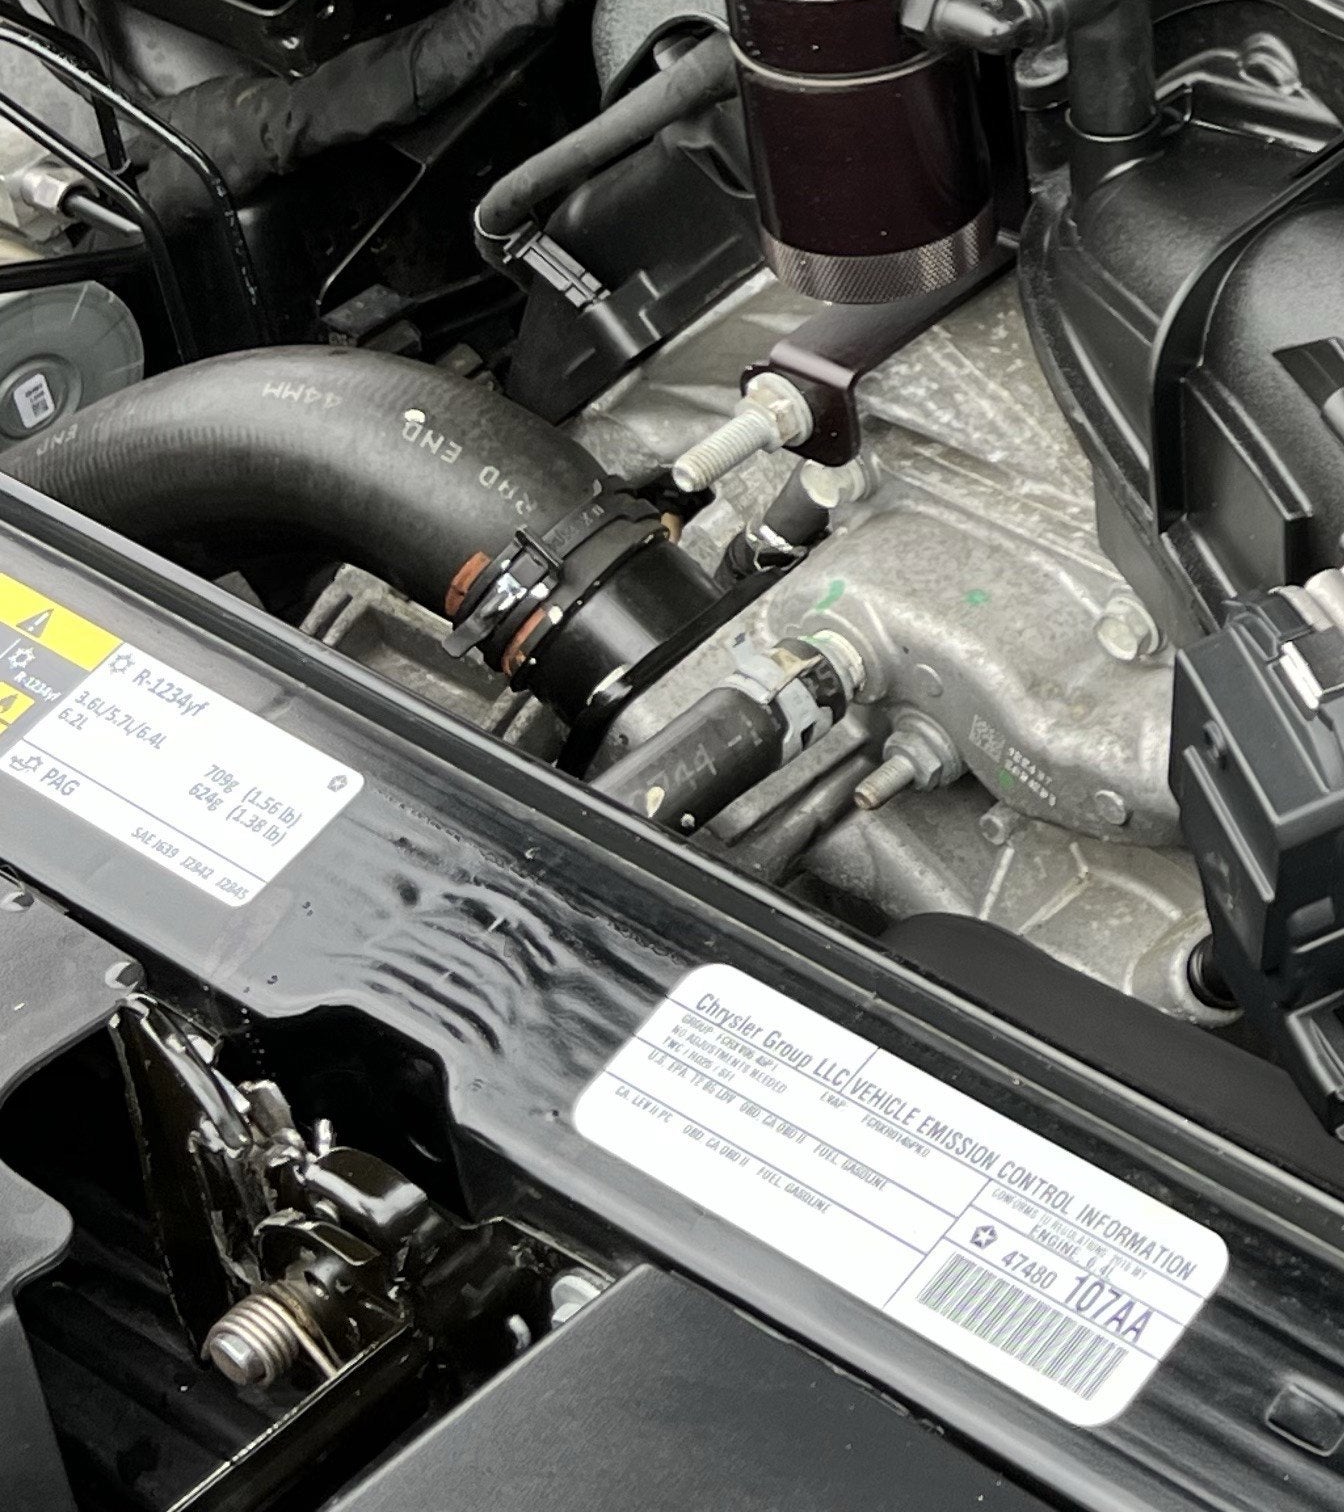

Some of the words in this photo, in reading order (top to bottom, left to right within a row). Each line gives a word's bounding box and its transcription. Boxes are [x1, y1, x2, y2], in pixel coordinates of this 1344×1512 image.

[401, 421, 462, 464] END
[57, 707, 89, 730] 6.2L
[74, 690, 167, 750] 3.6L/5.7L/6.4L
[132, 668, 209, 717] R-1234yf
[40, 767, 81, 796] PAG
[204, 764, 240, 794] 709g
[241, 786, 283, 815] (1.56
[277, 806, 302, 829] lb)
[130, 827, 157, 845] SAE
[188, 782, 224, 811] 624g
[225, 804, 268, 833] (1.38
[262, 824, 287, 847] lb)
[695, 993, 764, 1043] Chrysler
[759, 1030, 813, 1071] Group
[812, 1057, 851, 1087] LLC
[849, 1077, 921, 1126] VEHICLE
[920, 1115, 1002, 1171] EMISSION
[997, 1160, 1075, 1215] CONTROL
[1077, 1204, 1197, 1281] INFORMATION
[1001, 1250, 1058, 1290] 47480
[1063, 1275, 1156, 1344] 107AA
